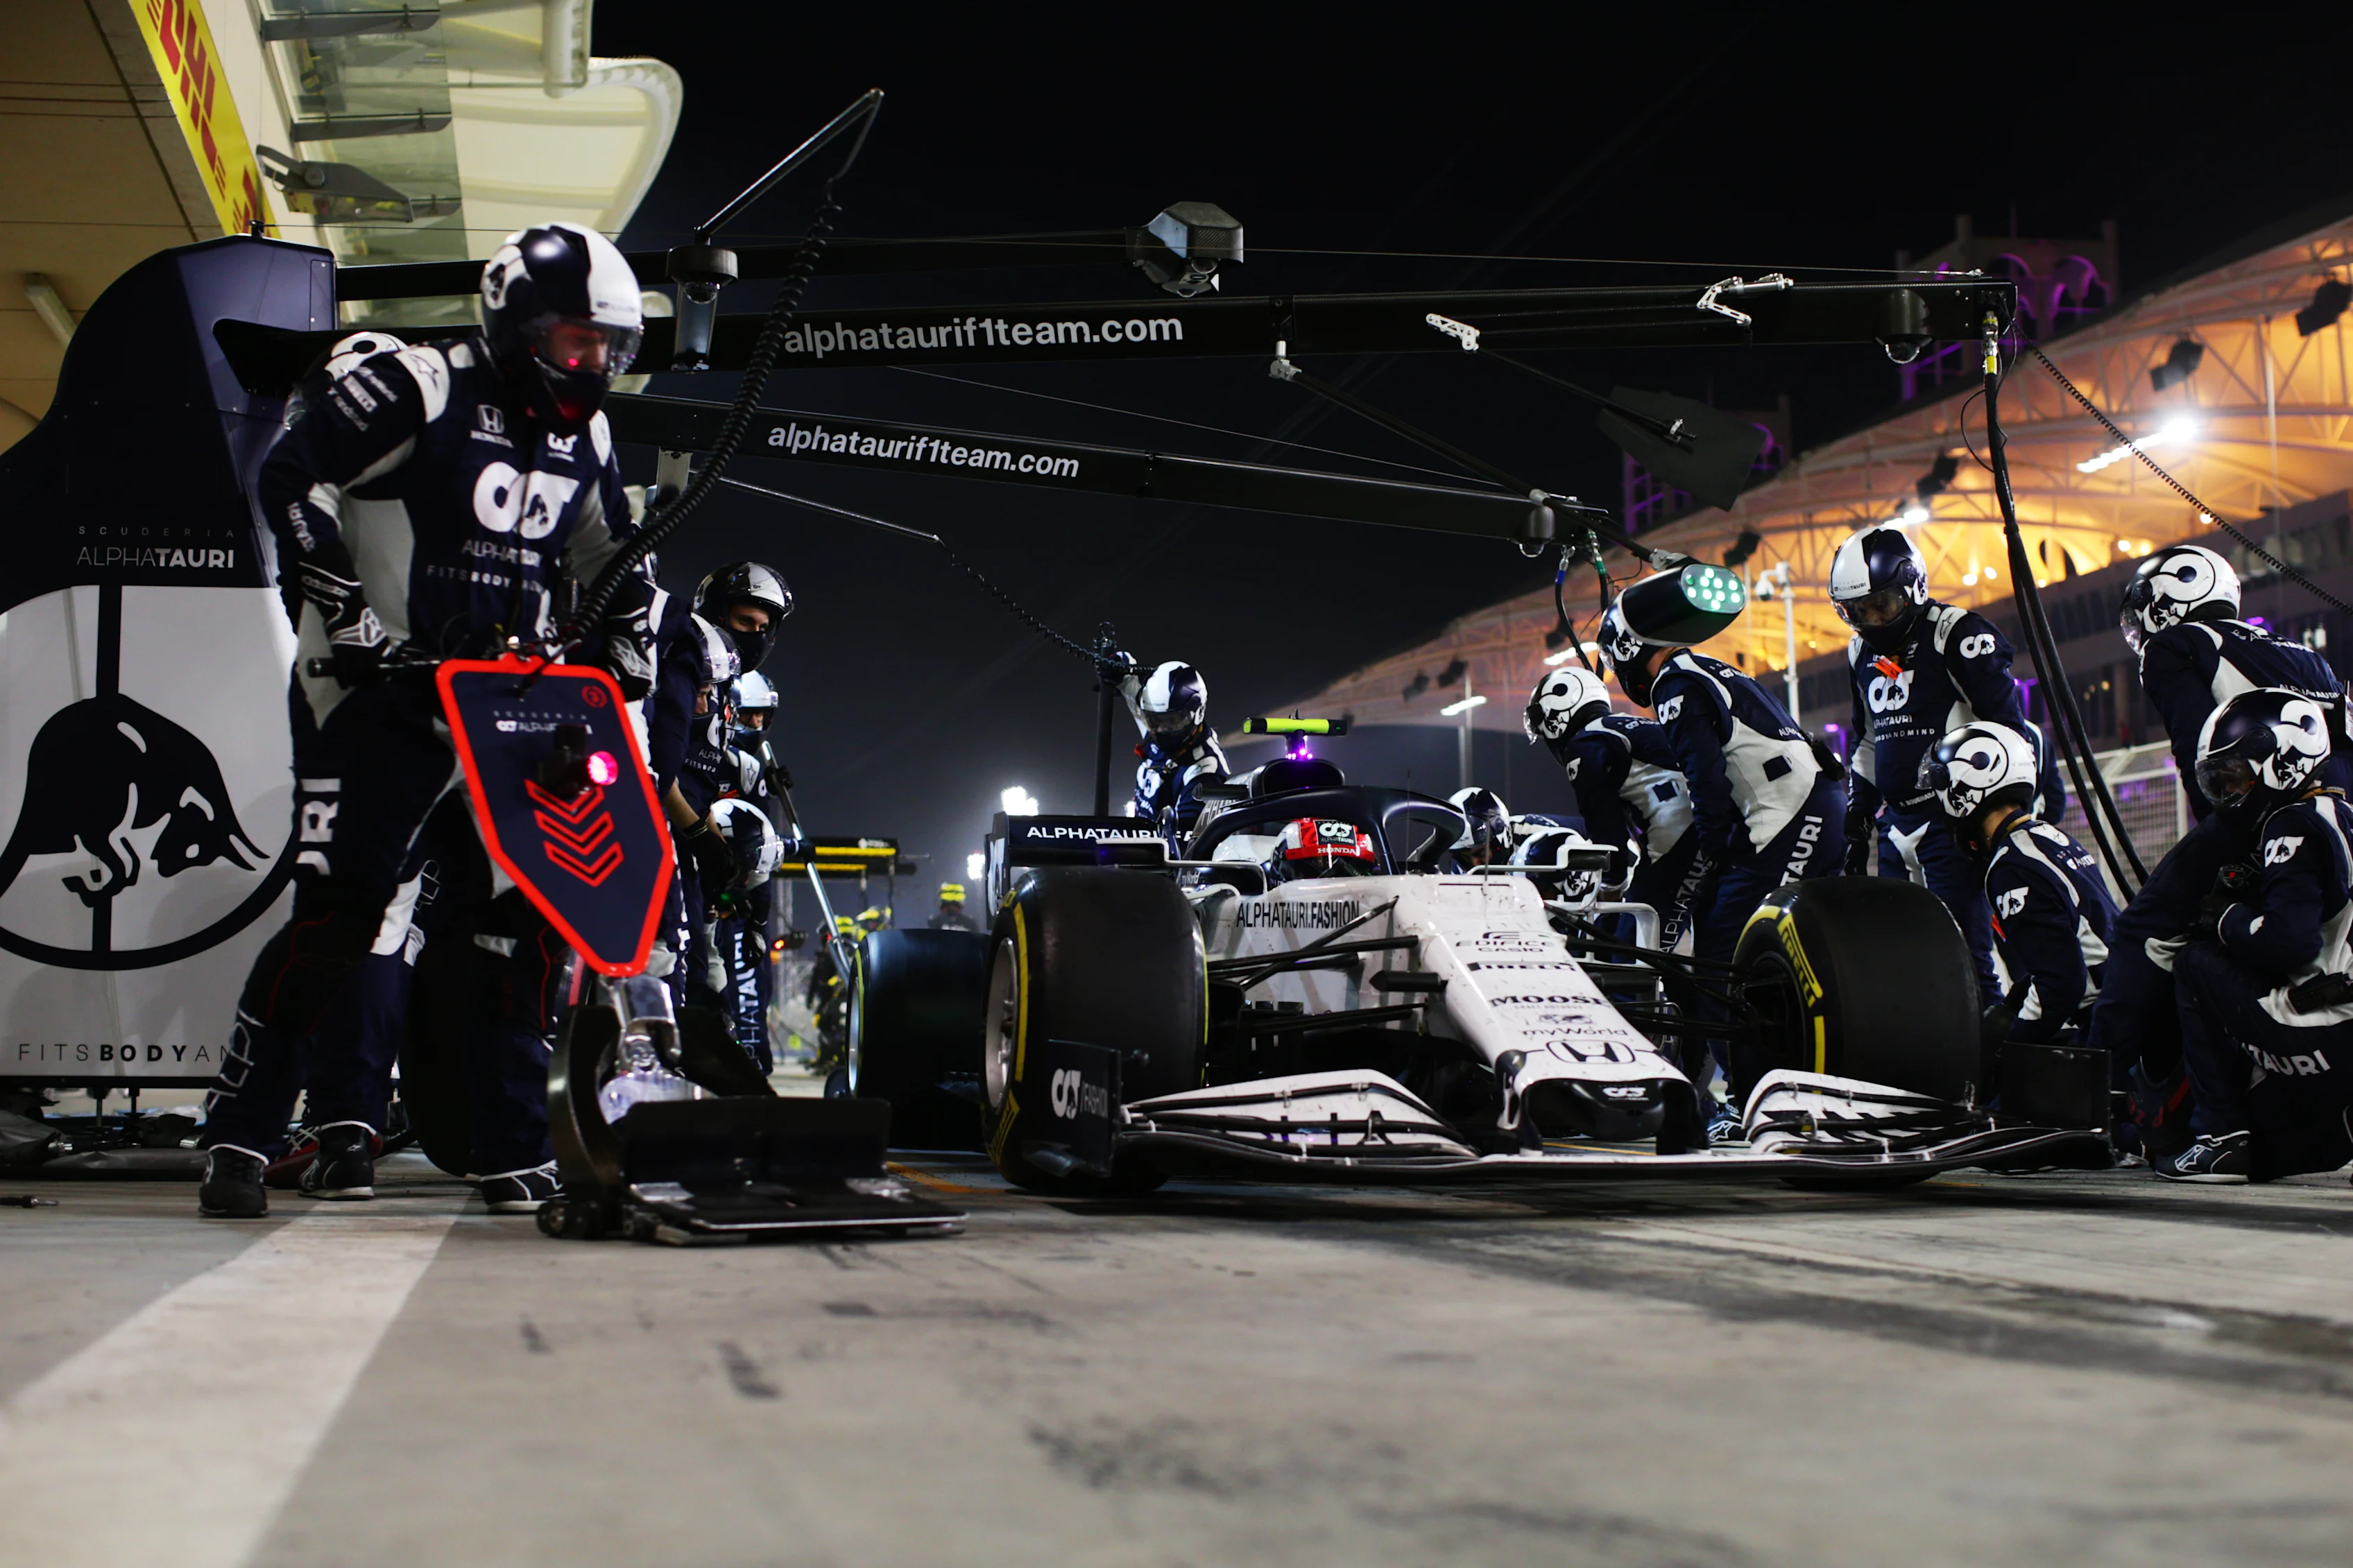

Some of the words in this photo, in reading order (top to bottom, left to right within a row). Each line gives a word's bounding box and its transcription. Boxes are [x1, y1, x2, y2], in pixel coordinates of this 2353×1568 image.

[785, 317, 1183, 359] alphataurif1team.com
[768, 422, 1079, 479] alphataurif1team.com
[78, 526, 234, 538] SCUDERIA
[76, 546, 234, 569] ALPHATAURI
[1235, 901, 1360, 929] ALPHATAURI.FASHION
[1489, 995, 1612, 1008] MOOSE
[1521, 1028, 1629, 1040] myWorld
